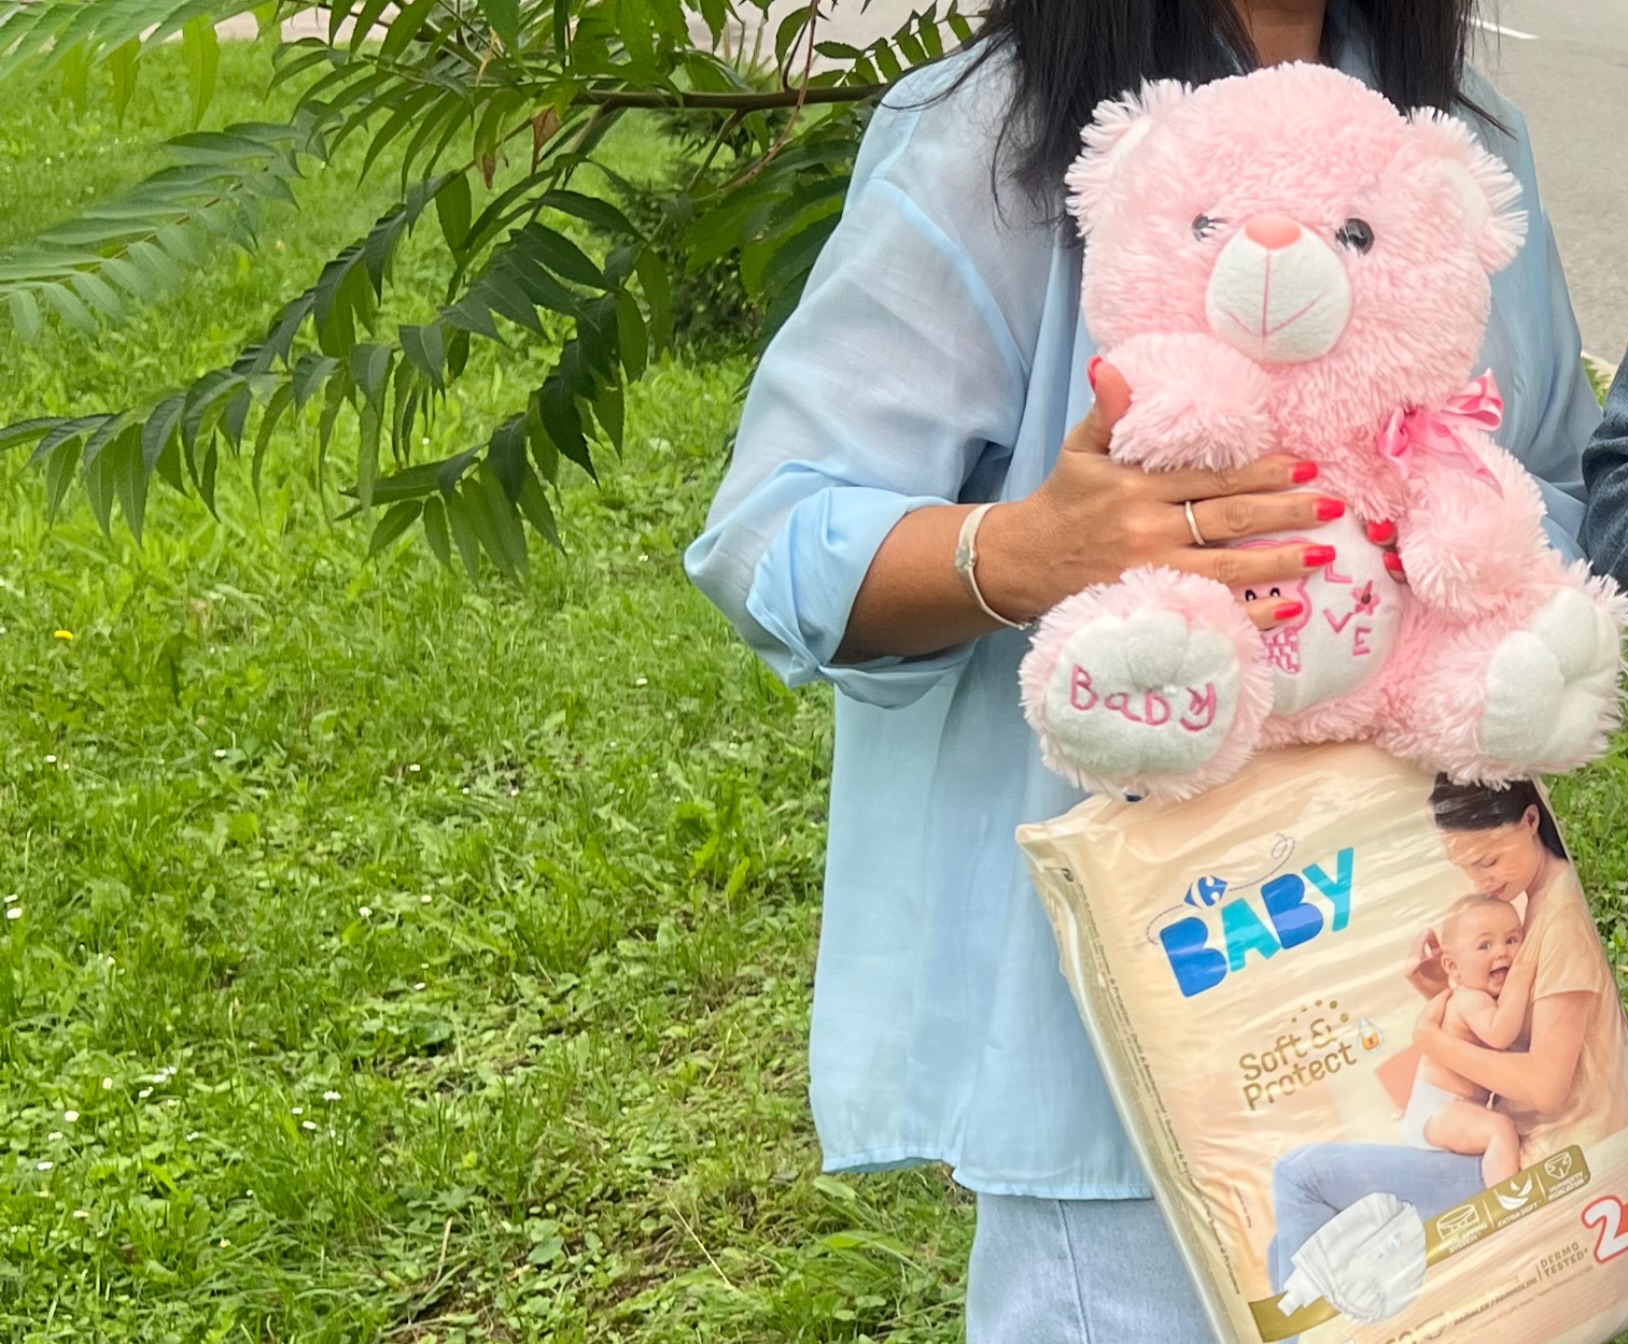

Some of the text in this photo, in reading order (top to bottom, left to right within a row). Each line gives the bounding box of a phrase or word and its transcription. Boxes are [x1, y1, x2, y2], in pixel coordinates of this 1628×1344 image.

[1159, 846, 1355, 998] BABY
[1239, 1017, 1338, 1082] Soft &
[1243, 1041, 1358, 1111] Protect
[1540, 1241, 1581, 1269] DERMO
